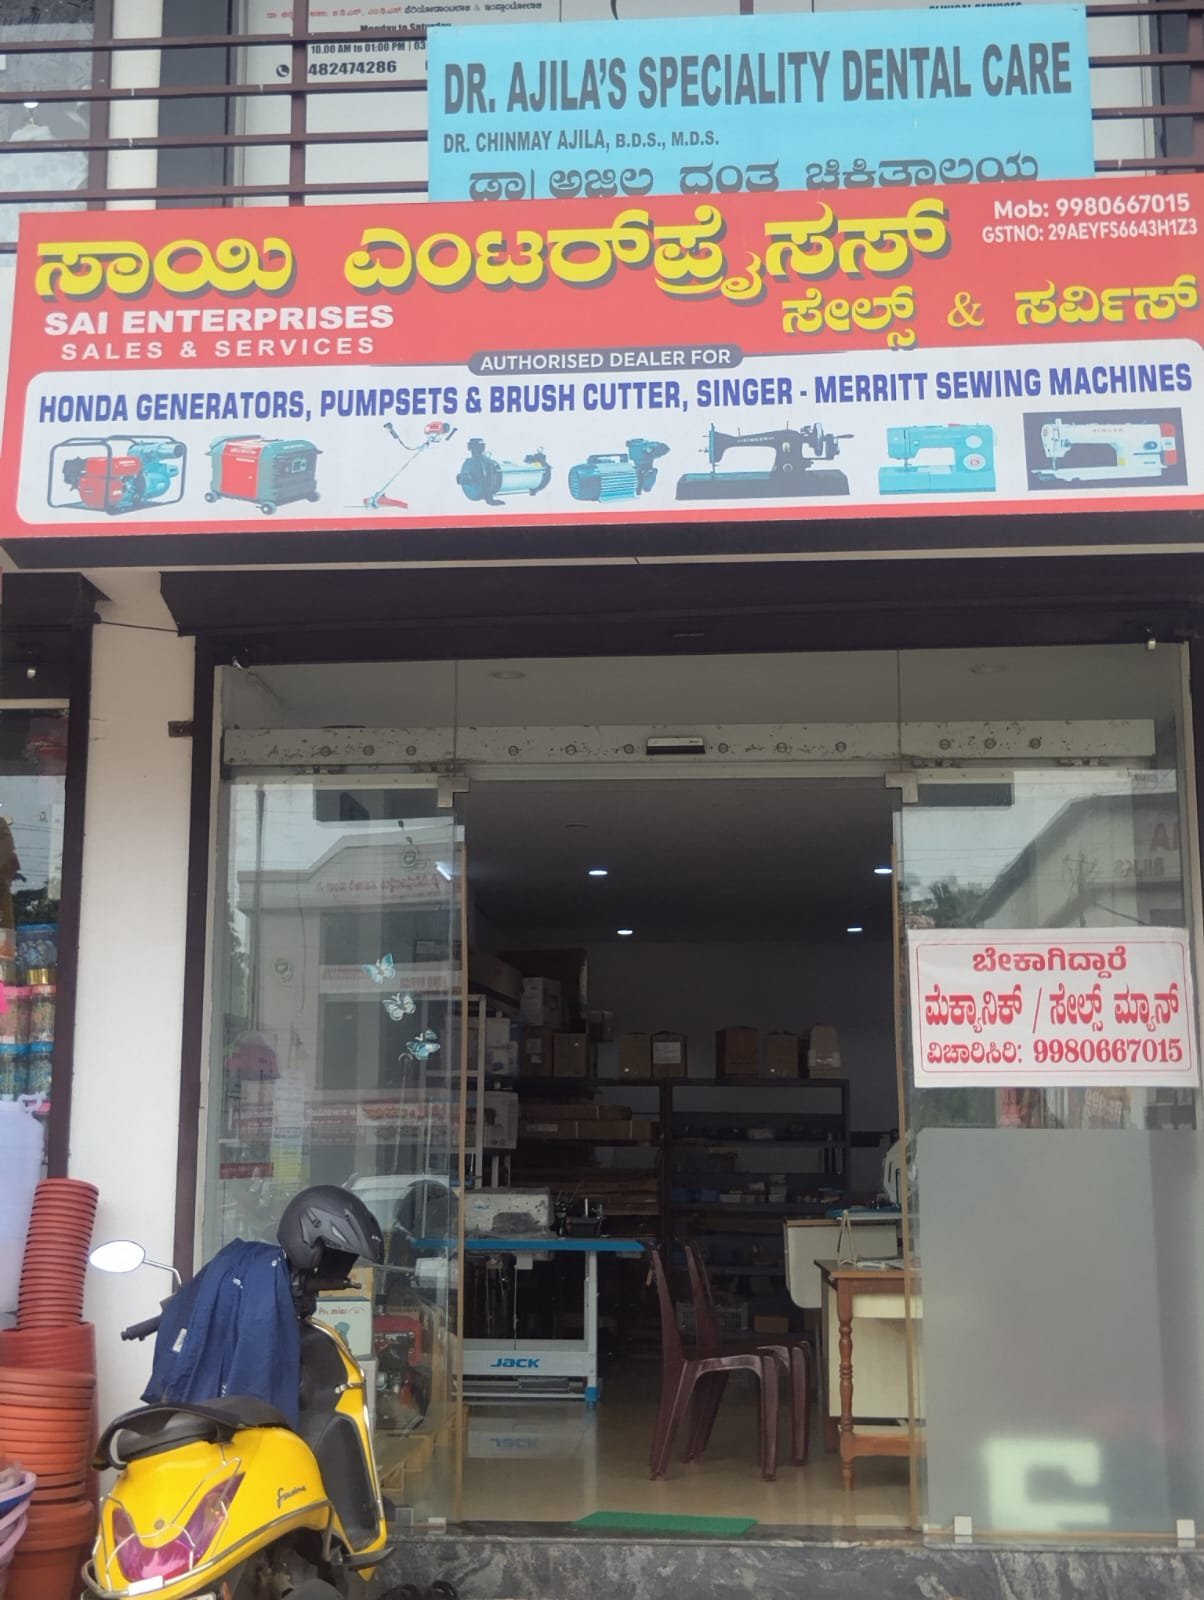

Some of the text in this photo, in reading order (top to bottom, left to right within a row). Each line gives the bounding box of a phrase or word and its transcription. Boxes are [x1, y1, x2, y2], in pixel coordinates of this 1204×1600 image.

[338, 43, 351, 53] AM
[392, 41, 406, 51] PM
[307, 60, 397, 76] 482474286
[444, 41, 1072, 115] DR. AJILA'S SPECIALITY DENTAL CARE
[443, 129, 719, 153] DR. CHINMAY AJILA, B.D.S., M.D.S.
[993, 193, 1191, 220] Mob: 9980667015
[981, 218, 1198, 244] GSTNO: 29AEYFS6643H1Z3
[35, 237, 296, 299] ಸಾಯಿ
[44, 304, 394, 336] SAI ENTERPRISES
[946, 291, 985, 328] &
[61, 336, 375, 361] SALES & SERVICES
[480, 349, 732, 372] AUTHORISED DEALER FOR
[39, 394, 129, 423] HONDA
[136, 390, 312, 421] GENERATORS,
[320, 386, 458, 418] PUMPSETS
[465, 385, 482, 413] &
[490, 383, 575, 413] BRUSH
[583, 381, 688, 412] CUTTER,
[696, 377, 793, 408] SINGER
[815, 371, 928, 404] MERRITT
[935, 369, 1041, 400] SEWING
[1048, 363, 1192, 395] MACHINES
[1033, 1038, 1183, 1064] 9980667015
